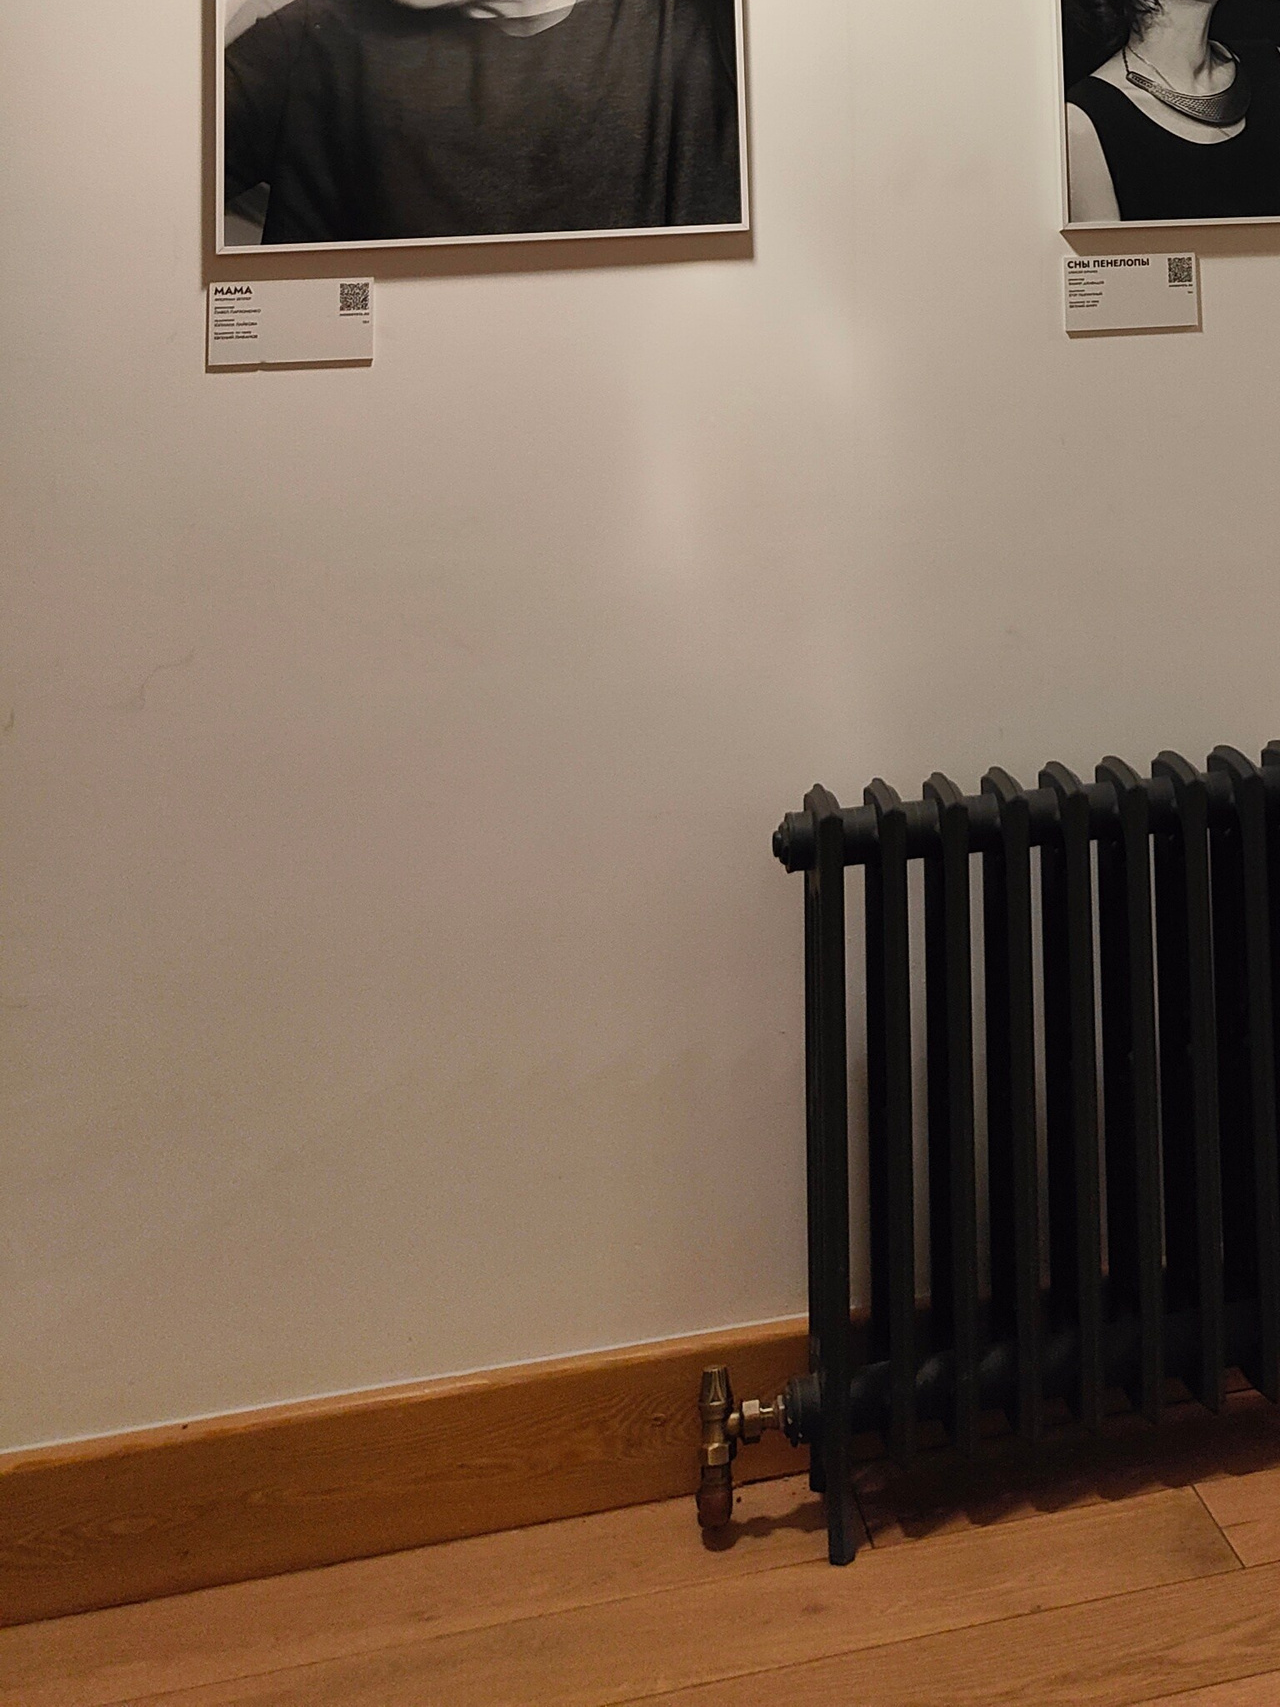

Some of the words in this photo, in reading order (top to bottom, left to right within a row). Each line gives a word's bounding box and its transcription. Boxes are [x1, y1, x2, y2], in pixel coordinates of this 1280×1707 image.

[1067, 260, 1090, 269] СНЫ
[1093, 258, 1150, 268] ПЕНЕЛОПЫ
[214, 286, 253, 295] МАМА
